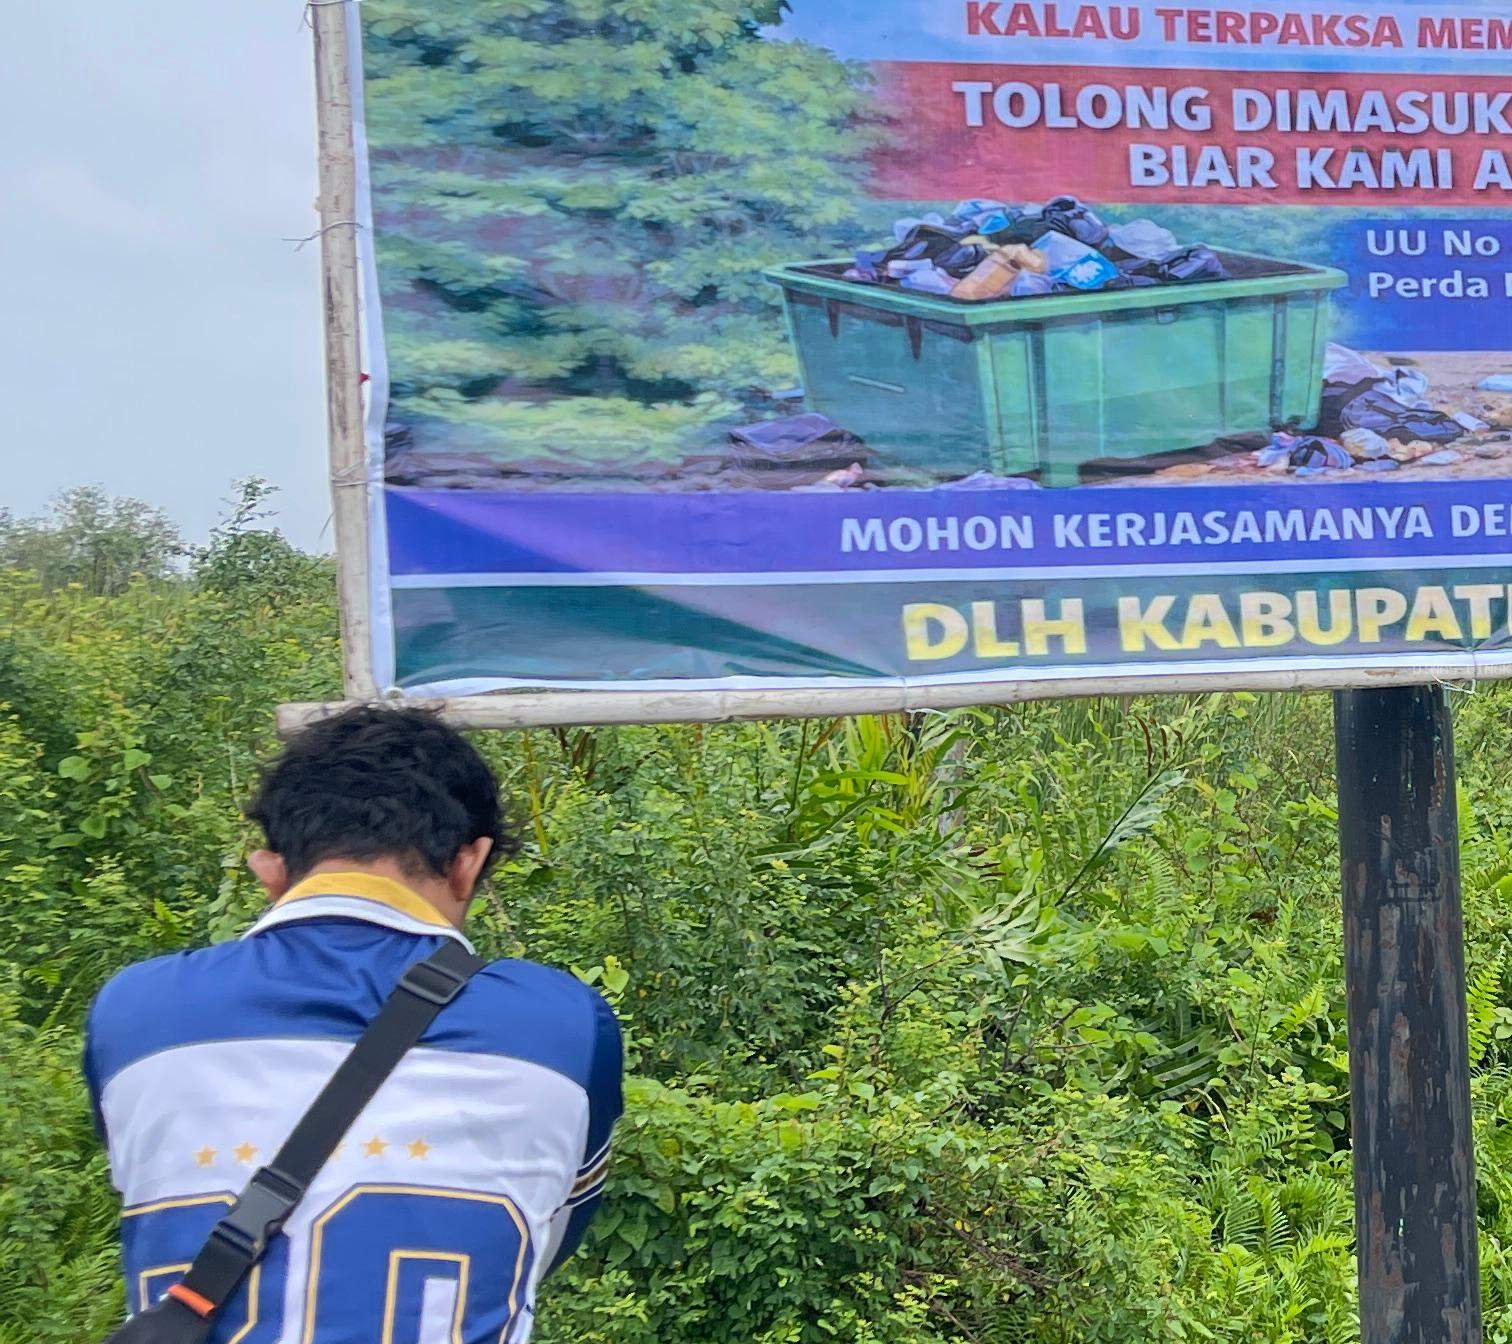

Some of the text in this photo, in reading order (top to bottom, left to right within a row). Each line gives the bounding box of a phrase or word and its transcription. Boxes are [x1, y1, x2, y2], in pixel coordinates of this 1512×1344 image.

[967, 1, 1140, 40] KALAU
[1155, 8, 1402, 48] TERPAKSA
[952, 81, 1211, 131] TOLONG
[1129, 143, 1279, 189] BIAR
[1296, 146, 1453, 190] KAMI
[1366, 229, 1427, 255] UU
[1444, 229, 1501, 256] No
[1368, 270, 1490, 298] Perda
[840, 514, 1035, 553] MOHON
[1053, 505, 1434, 549] KERJASAMANYA
[902, 597, 1087, 661] DLH
